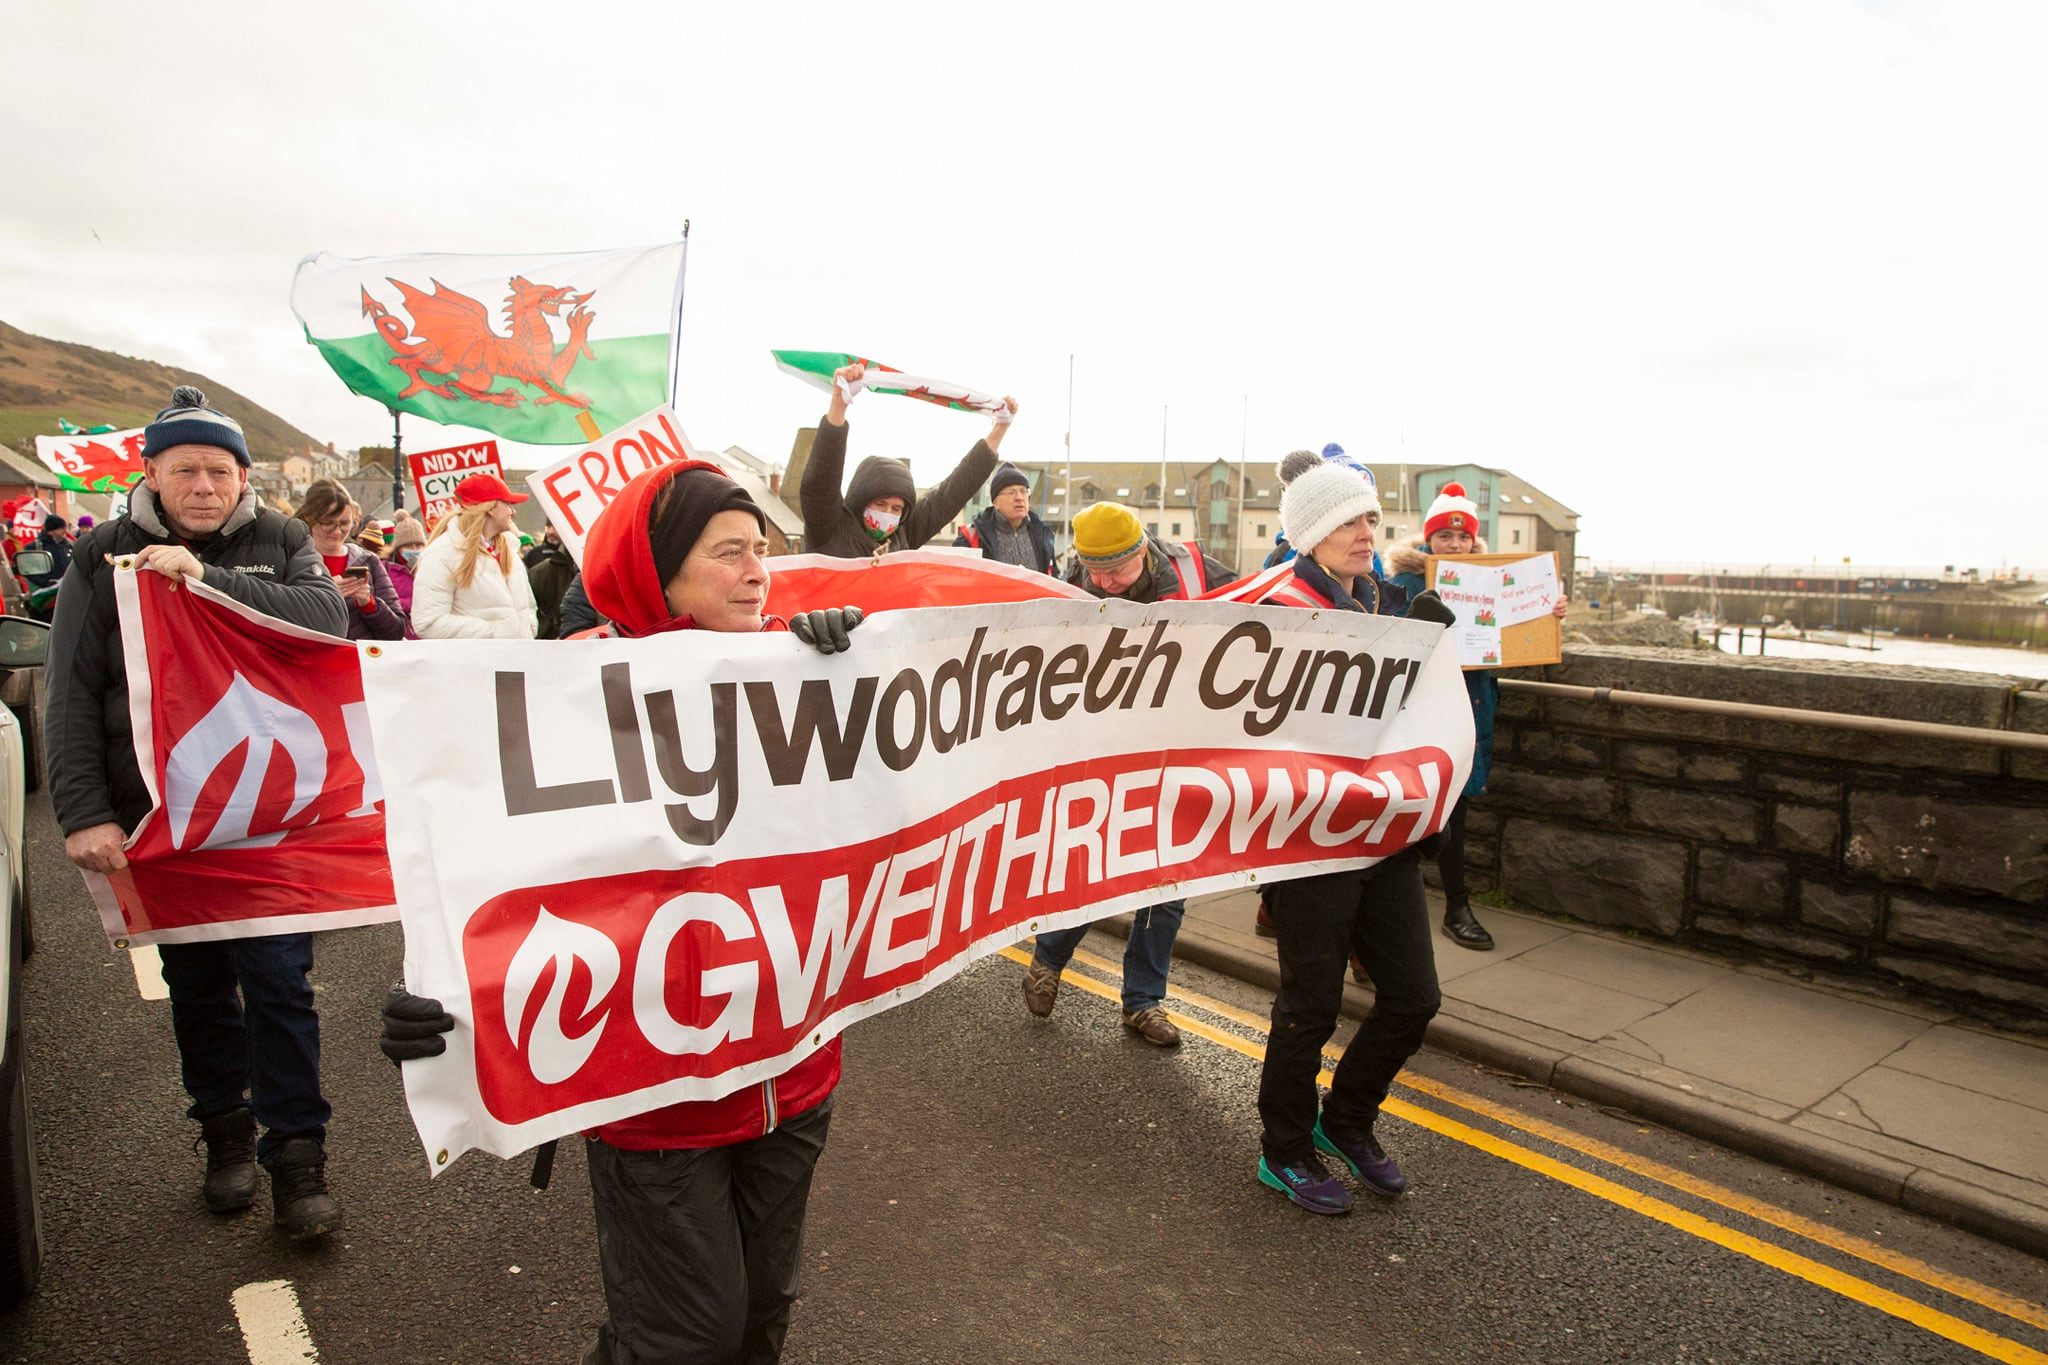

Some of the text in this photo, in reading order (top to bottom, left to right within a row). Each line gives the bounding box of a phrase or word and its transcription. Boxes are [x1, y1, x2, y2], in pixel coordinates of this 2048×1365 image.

[422, 446, 488, 474] NID YW
[494, 619, 1182, 846] Llywodraeth
[632, 761, 1441, 1056] GWEITHREDWCH
